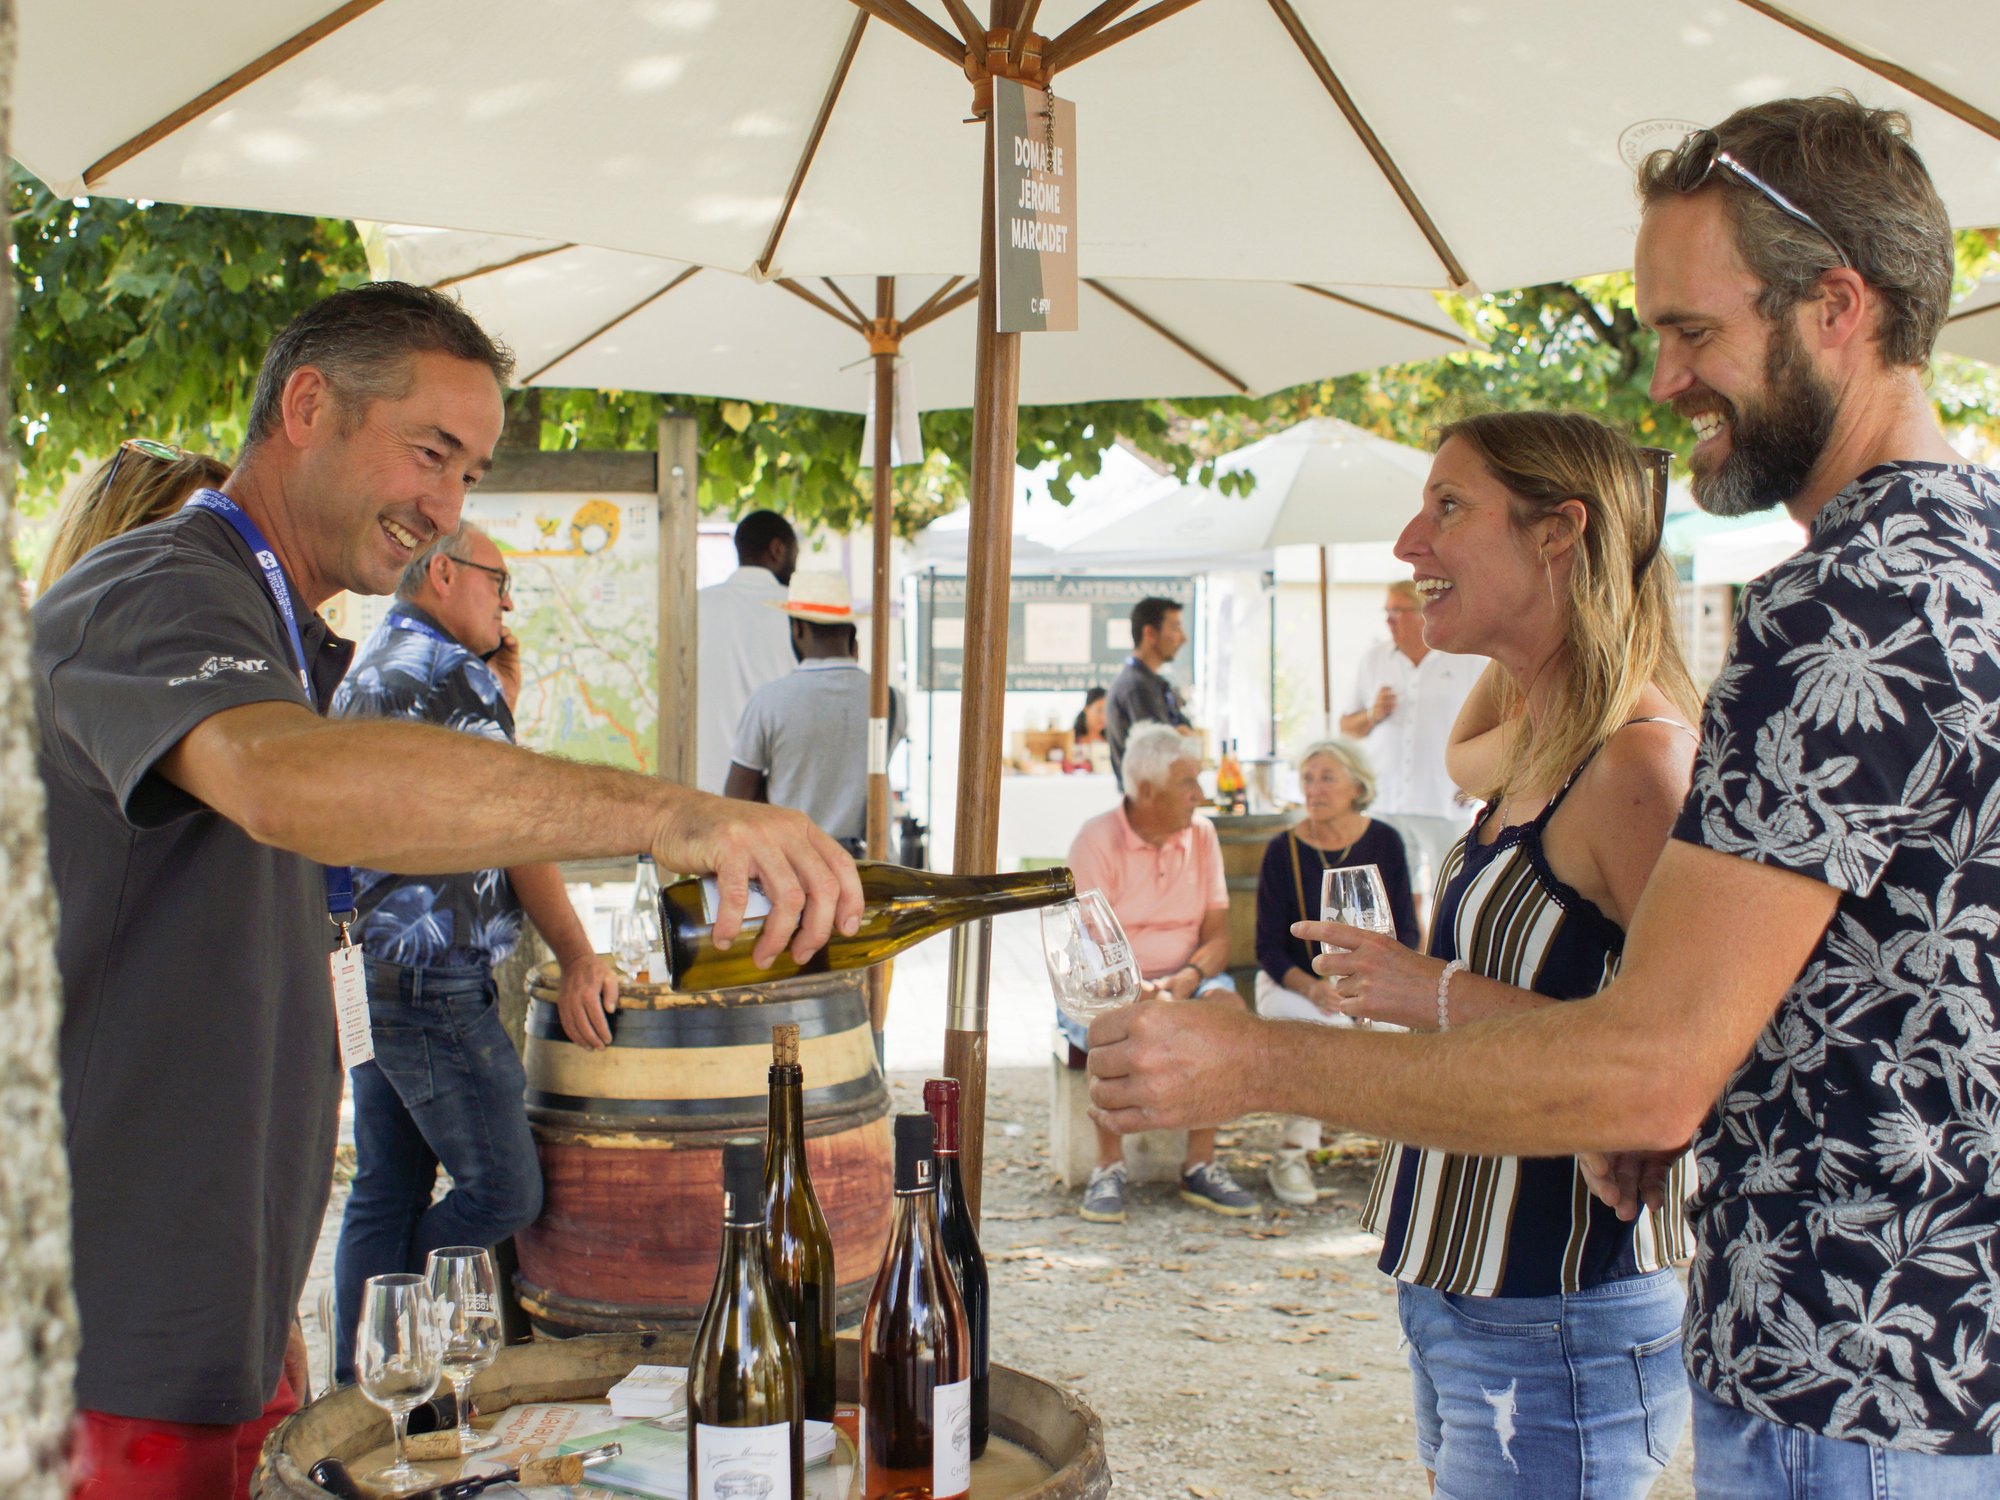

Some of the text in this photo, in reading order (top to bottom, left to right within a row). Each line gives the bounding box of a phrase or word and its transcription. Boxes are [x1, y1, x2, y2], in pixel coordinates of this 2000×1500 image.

[1014, 135, 1064, 177] DOMANE
[1018, 169, 1061, 214] JÉRÔME
[1011, 217, 1068, 254] MARCADET
[519, 1406, 575, 1446] Cheverny
